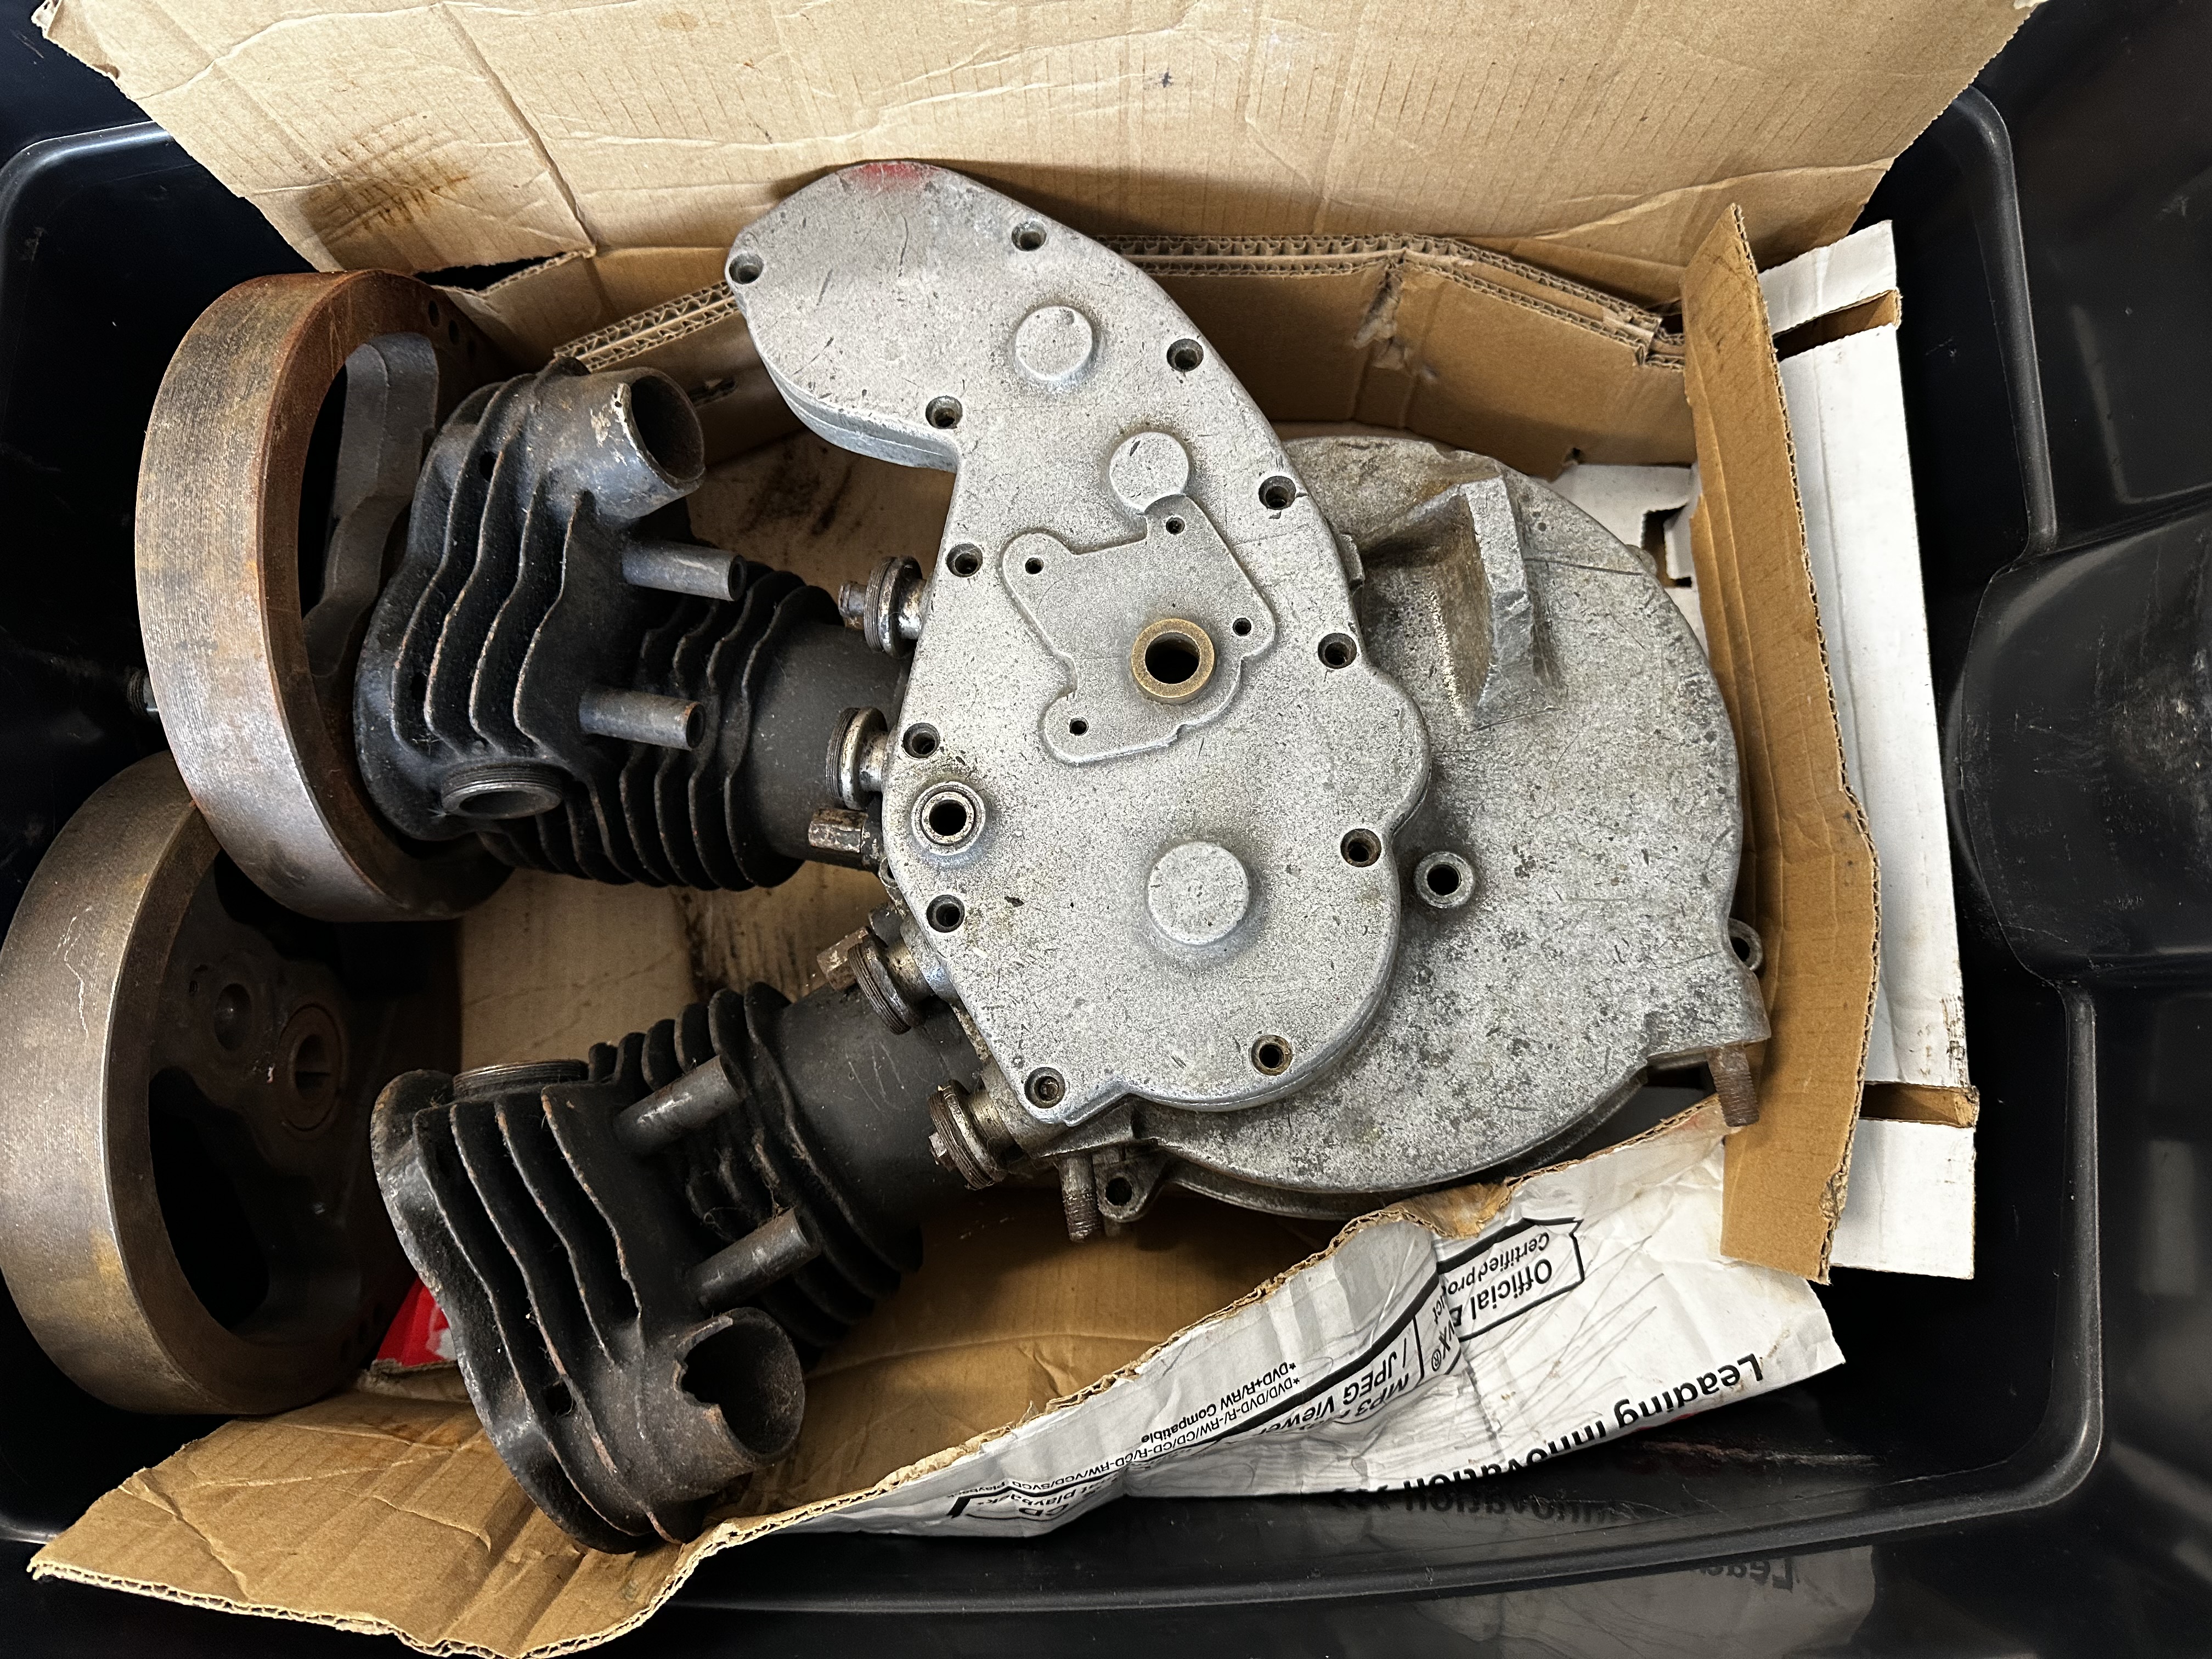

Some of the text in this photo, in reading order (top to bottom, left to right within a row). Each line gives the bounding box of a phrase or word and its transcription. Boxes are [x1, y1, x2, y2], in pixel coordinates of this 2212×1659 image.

[1432, 1232, 1550, 1325] Certified proct
[1470, 1259, 1553, 1321] Official
[1342, 1351, 1397, 1405] JPEG
[1355, 1373, 1409, 1417] MP3
[1613, 1353, 1763, 1429] Leading
[1141, 1403, 1216, 1444] Compatible
